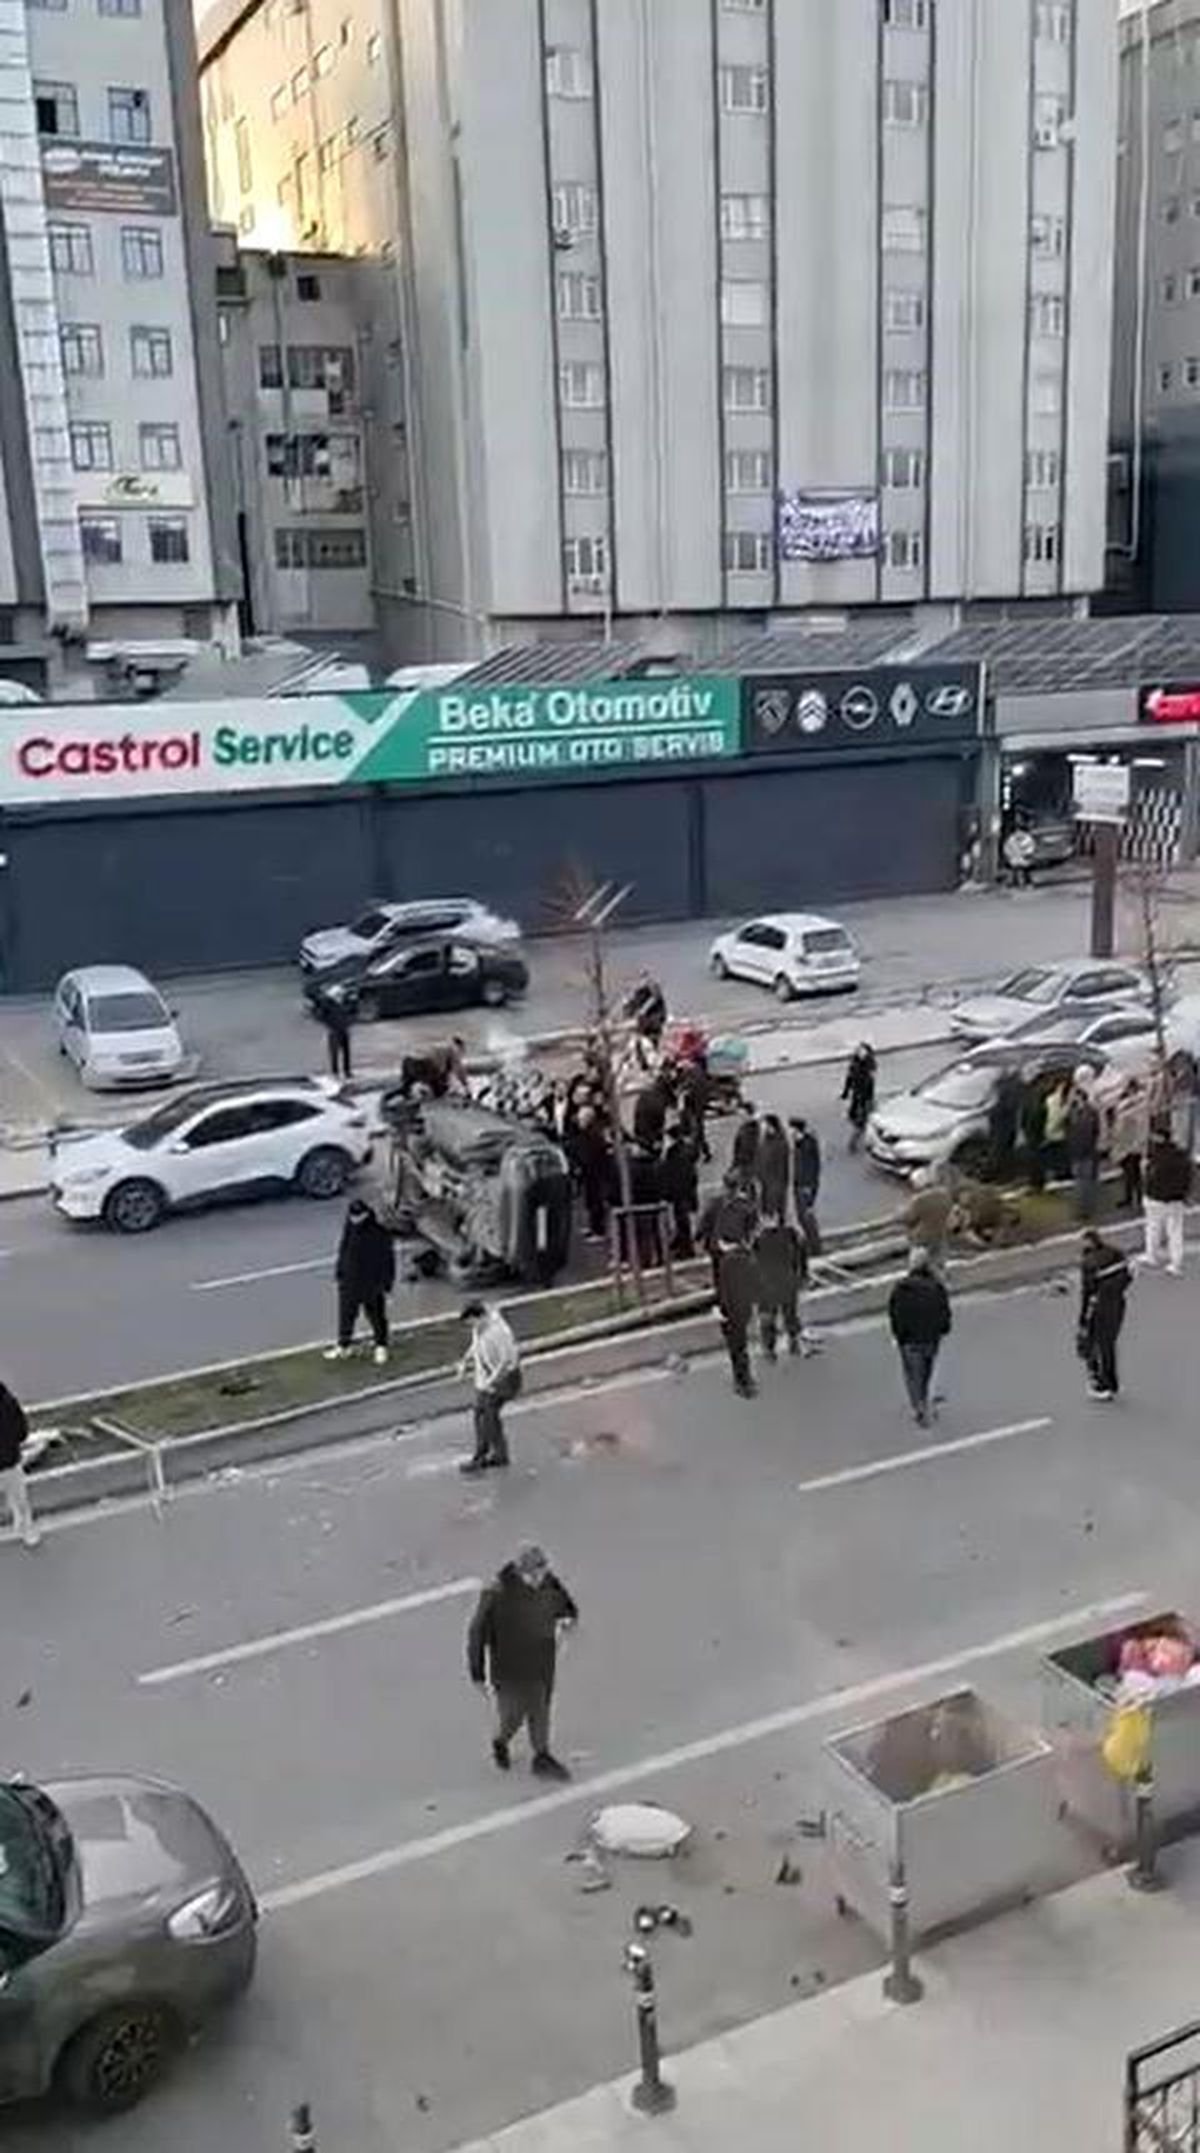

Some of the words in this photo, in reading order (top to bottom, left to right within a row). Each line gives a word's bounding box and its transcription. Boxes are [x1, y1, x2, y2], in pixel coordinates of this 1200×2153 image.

[547, 684, 713, 725] Otomotiv
[19, 731, 200, 777] Castrol
[213, 723, 354, 765] Service
[428, 741, 559, 773] PREMIUM
[569, 736, 622, 762] OTO
